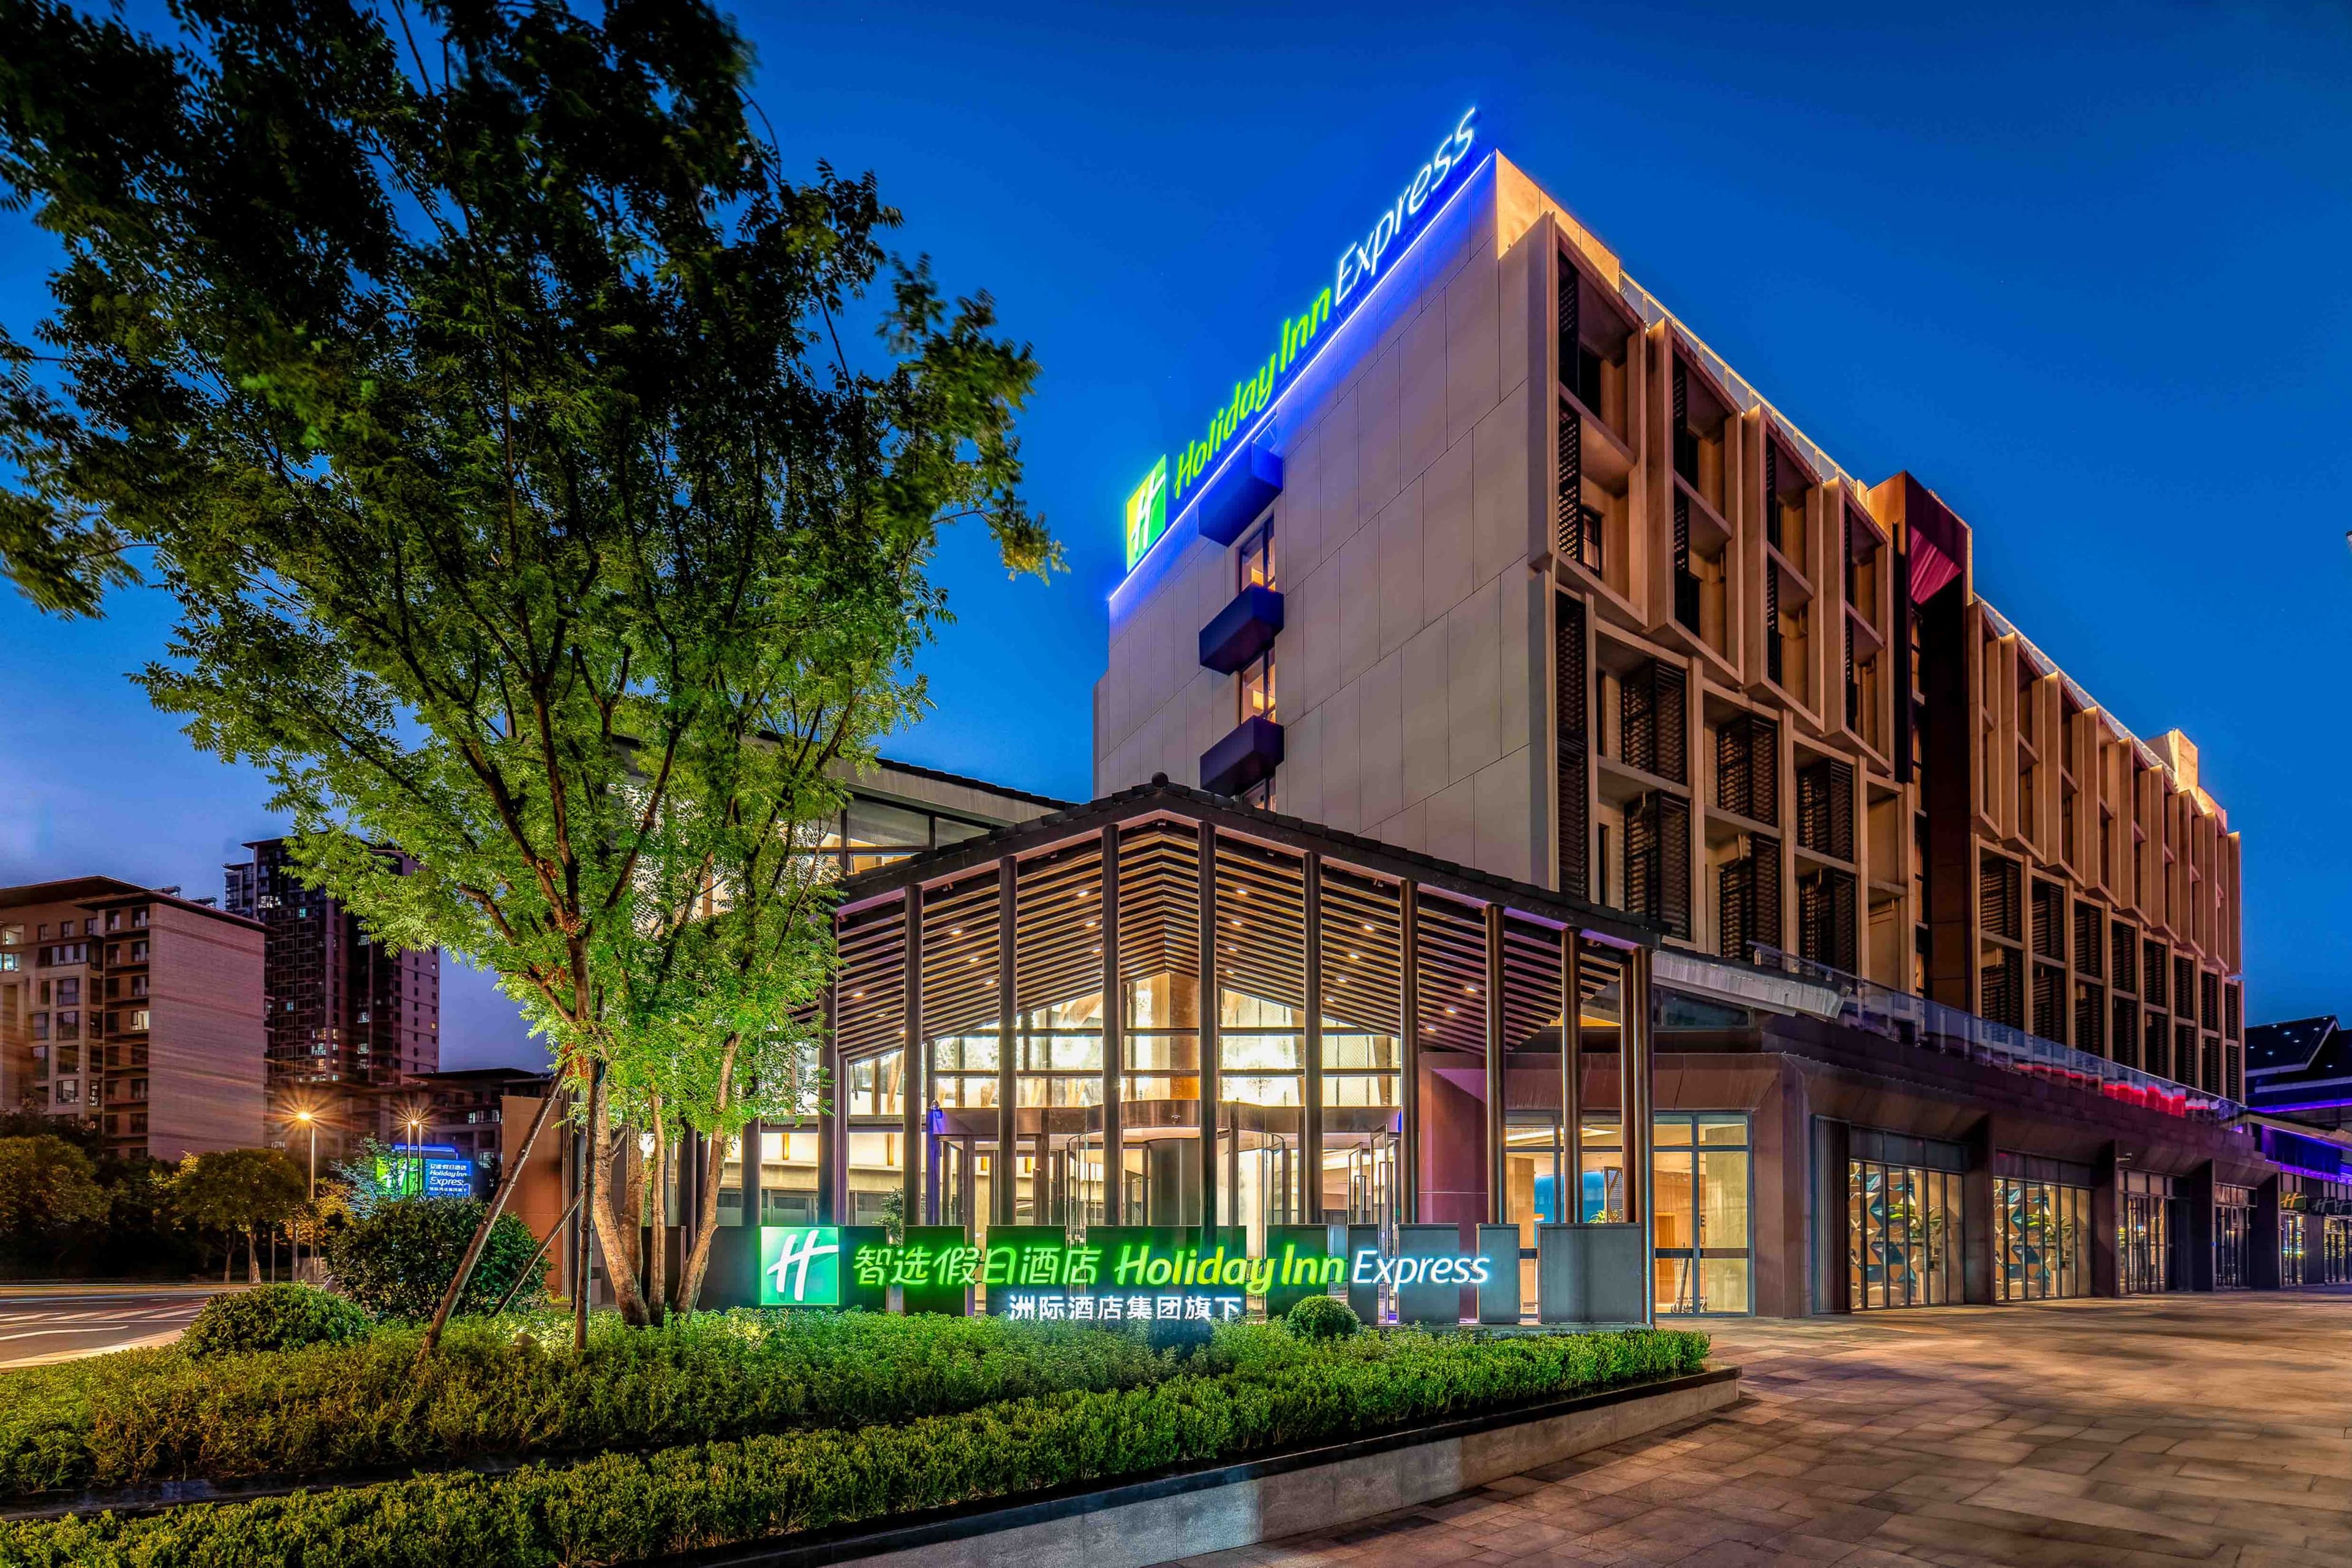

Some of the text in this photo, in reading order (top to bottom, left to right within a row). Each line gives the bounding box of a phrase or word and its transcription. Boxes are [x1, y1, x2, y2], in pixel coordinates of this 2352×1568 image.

[1174, 107, 1477, 499] Holiday Inn Express
[430, 1177, 464, 1186] Expres
[853, 1244, 1491, 1294] 智选假日酒店 Holiday Inn Express
[1009, 1294, 1242, 1322] 洲际酒店集团旗下
